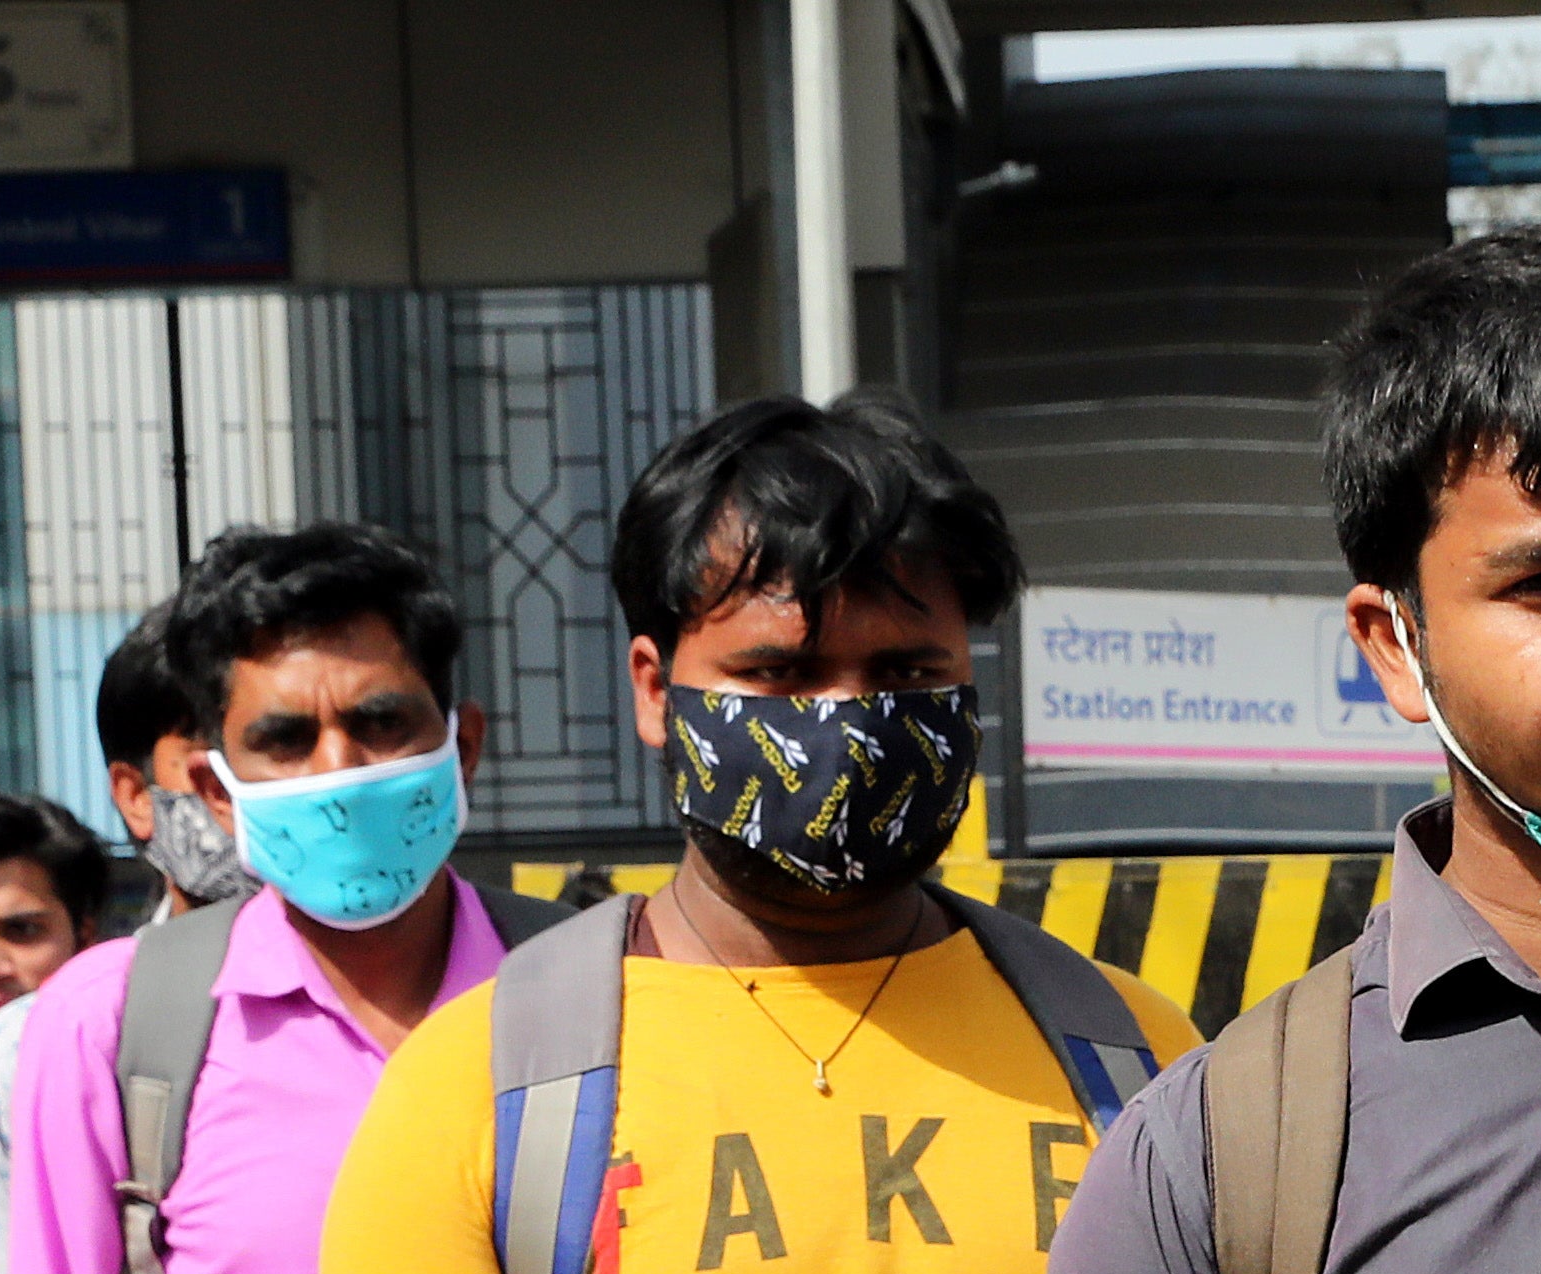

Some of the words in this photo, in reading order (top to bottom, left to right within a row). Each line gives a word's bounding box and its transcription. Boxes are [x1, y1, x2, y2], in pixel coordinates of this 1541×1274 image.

[1042, 615, 1130, 667] स्टेशन
[1142, 617, 1216, 667] प्रवेश
[1043, 685, 1155, 723] Station
[1165, 690, 1297, 725] Entrance
[746, 717, 805, 794] Reebok
[721, 774, 763, 837] Reebok
[805, 772, 852, 842] Reebok
